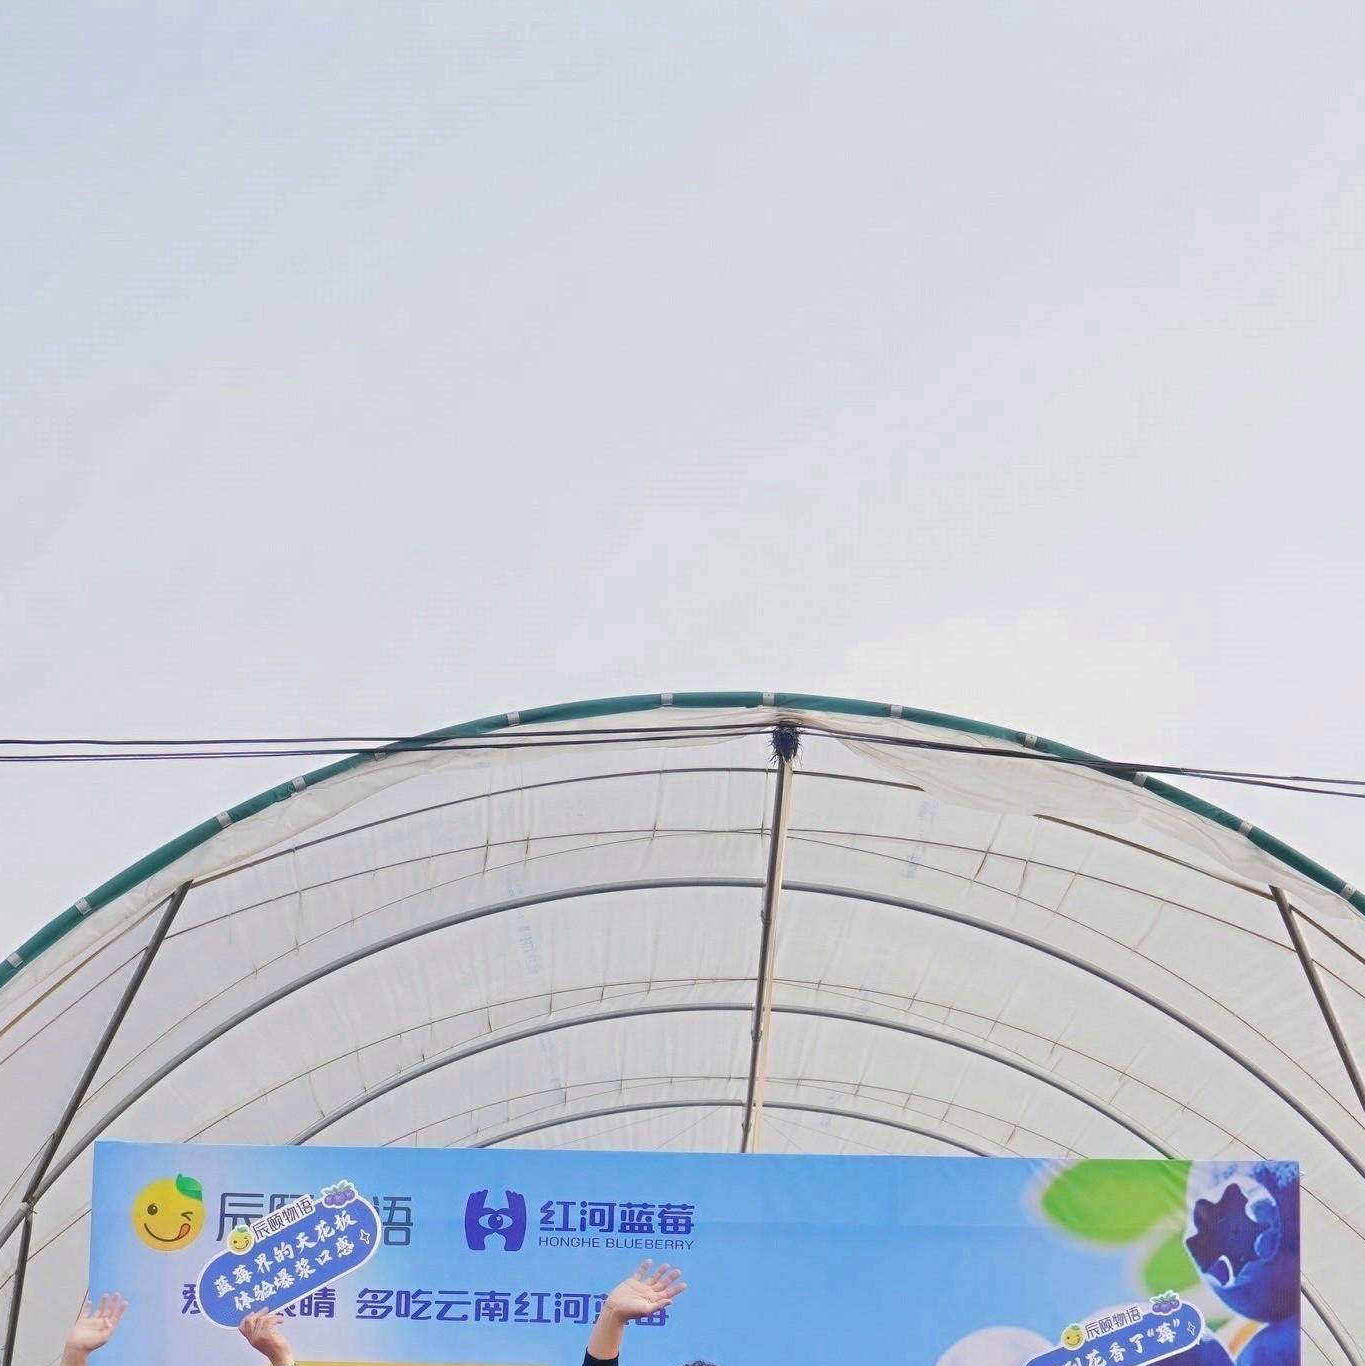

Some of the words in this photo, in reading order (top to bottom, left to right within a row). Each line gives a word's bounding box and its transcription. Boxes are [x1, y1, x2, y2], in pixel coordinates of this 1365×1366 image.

[252, 1195, 315, 1241] 辰颐物语
[539, 1199, 695, 1235] 红河蓝莓
[214, 1209, 358, 1299] 蓝莓界的天花板
[539, 1236, 602, 1249] HONGHE
[605, 1237, 695, 1251] BLUEBERRY
[233, 1234, 356, 1312] 体验爆浆口感
[1085, 1307, 1142, 1340] 辰颐物语
